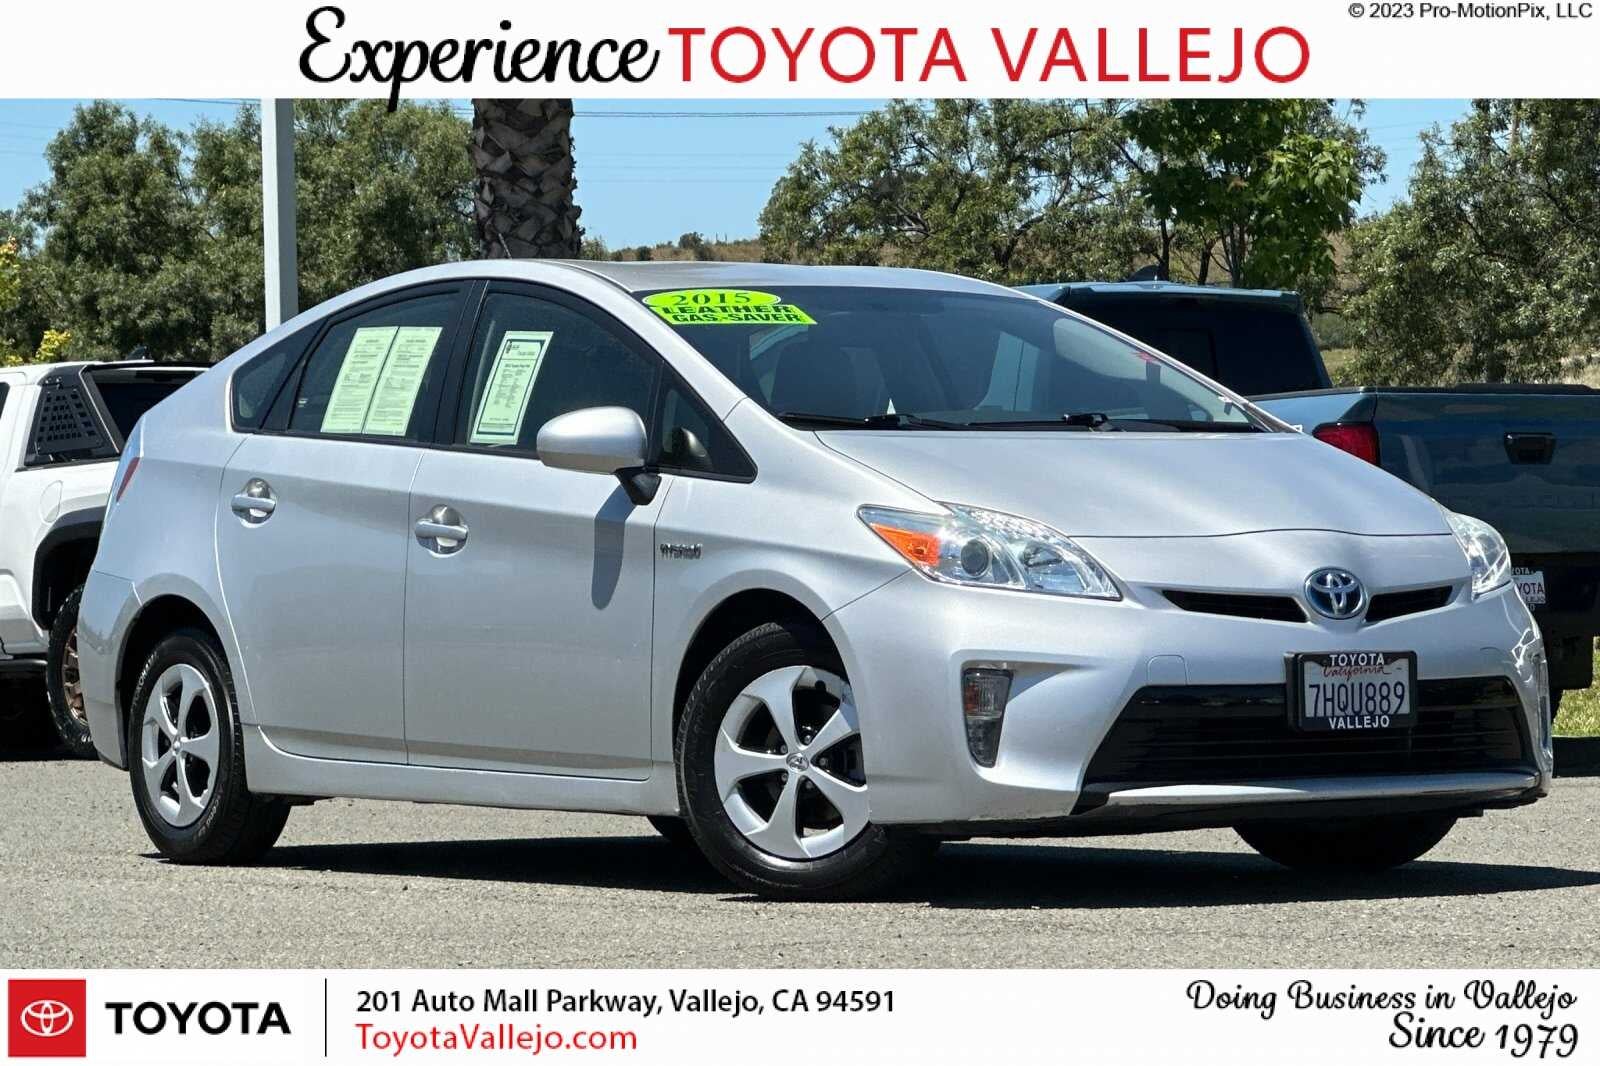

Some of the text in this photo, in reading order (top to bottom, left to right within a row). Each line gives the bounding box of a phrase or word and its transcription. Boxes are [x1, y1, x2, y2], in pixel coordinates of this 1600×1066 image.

[671, 292, 751, 306] 2015
[662, 304, 793, 314] LEATHER
[672, 313, 801, 322] GAS-SAVER
[1329, 653, 1385, 666] TOYOTA
[1322, 666, 1392, 681] California
[1308, 680, 1406, 716] 7HQU889
[1328, 715, 1391, 729] VALLEJO
